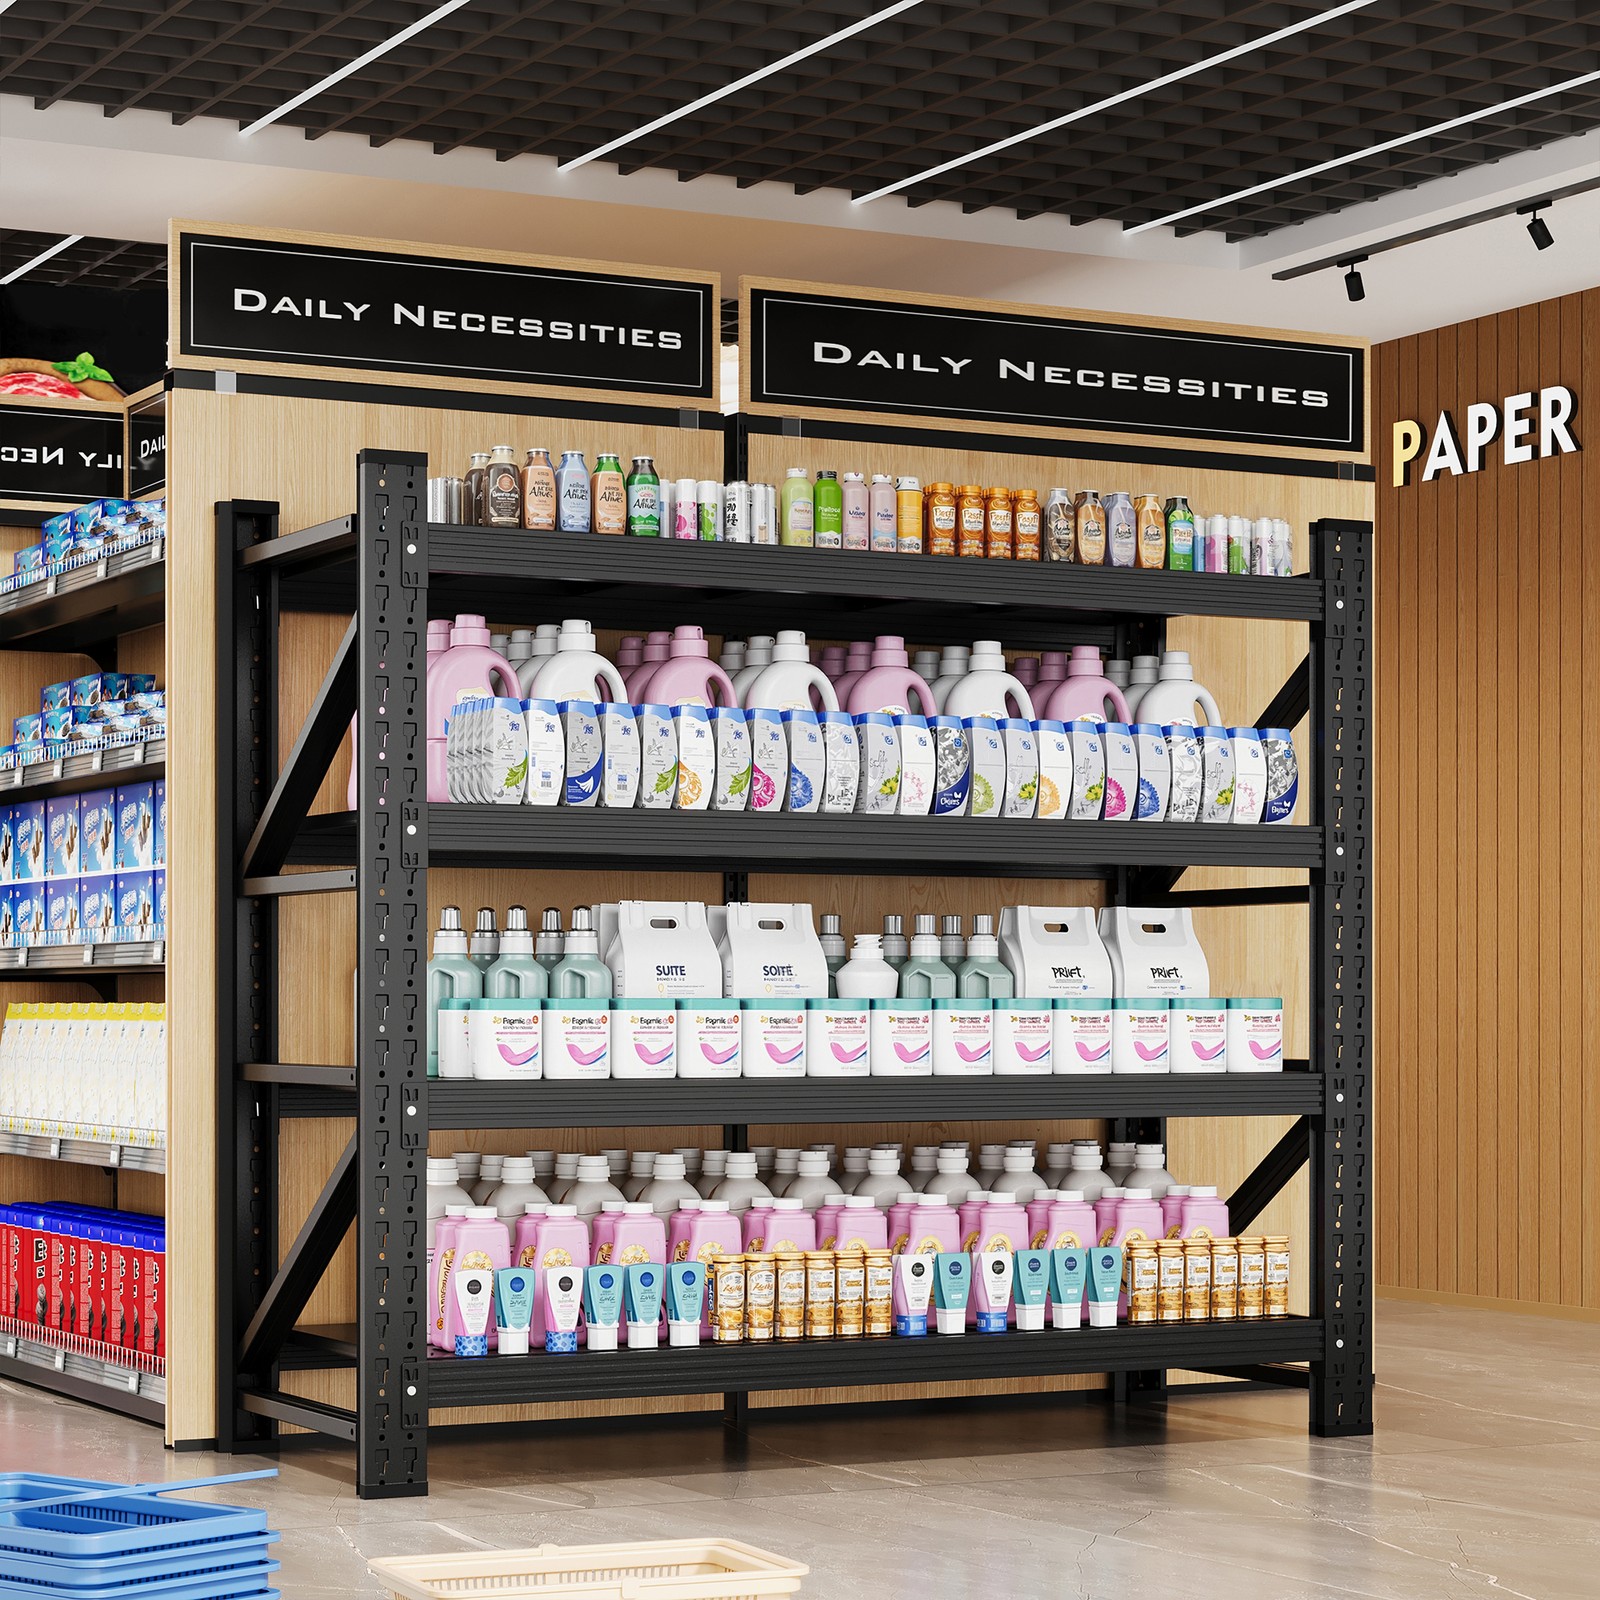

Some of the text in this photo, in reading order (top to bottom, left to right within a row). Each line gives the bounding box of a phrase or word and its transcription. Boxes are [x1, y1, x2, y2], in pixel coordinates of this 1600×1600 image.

[234, 288, 683, 350] DAILY NECESSITIES
[813, 342, 1330, 408] DAILY NECESSITIES
[1393, 385, 1577, 488] PAPER
[655, 965, 687, 977] SUITE
